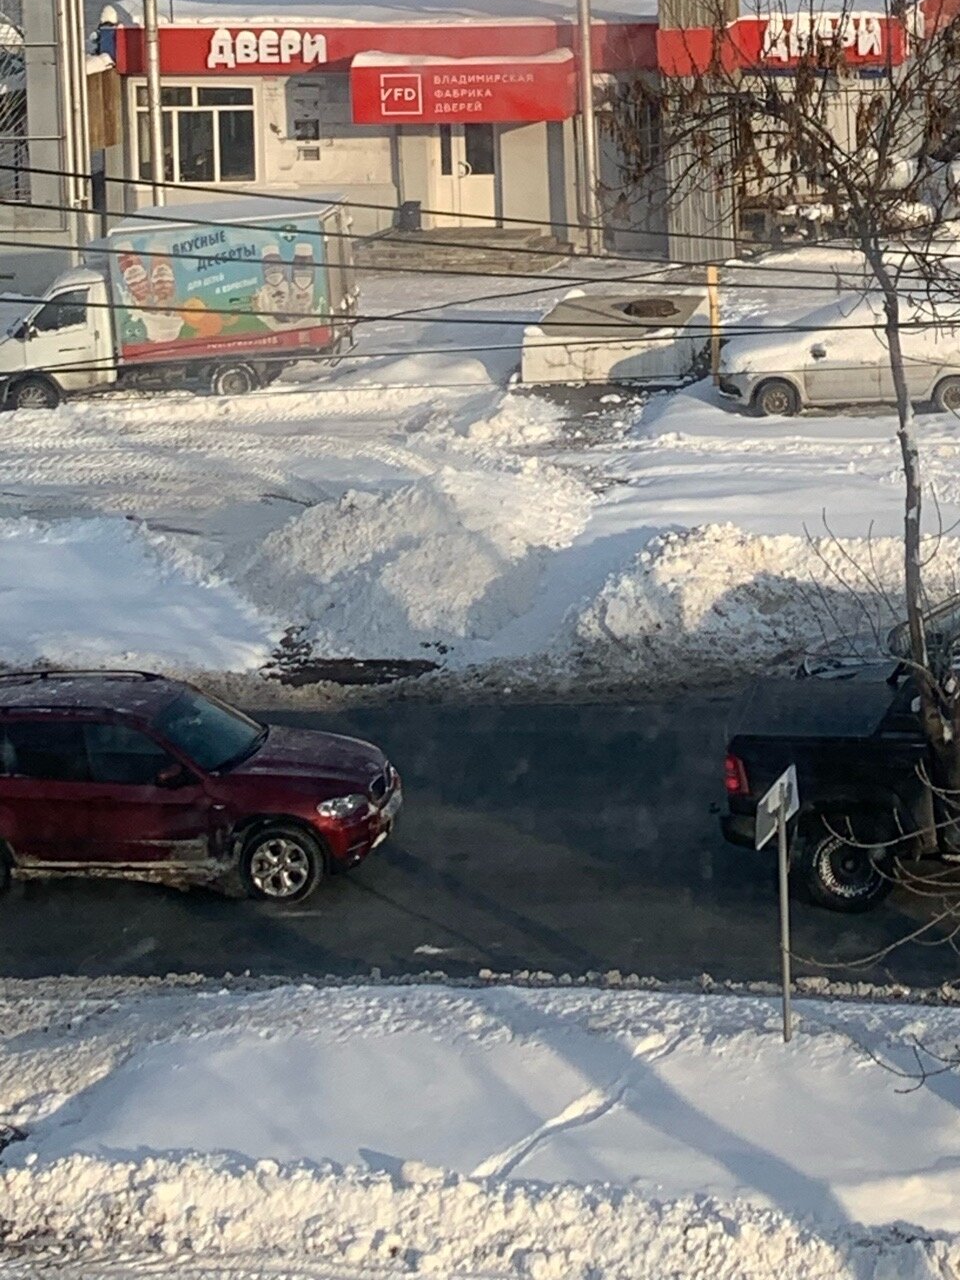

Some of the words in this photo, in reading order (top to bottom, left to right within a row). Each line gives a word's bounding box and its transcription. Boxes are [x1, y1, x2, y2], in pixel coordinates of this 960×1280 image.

[207, 27, 327, 69] ДВЕРИ
[433, 74, 534, 85] ВЛАДИМИРСКАЯ
[380, 88, 416, 101] VFD
[433, 88, 493, 99] ФАБРИКА
[433, 101, 483, 114] ДВЕРЕЙ
[172, 230, 226, 255] ВКУСНЫЕ
